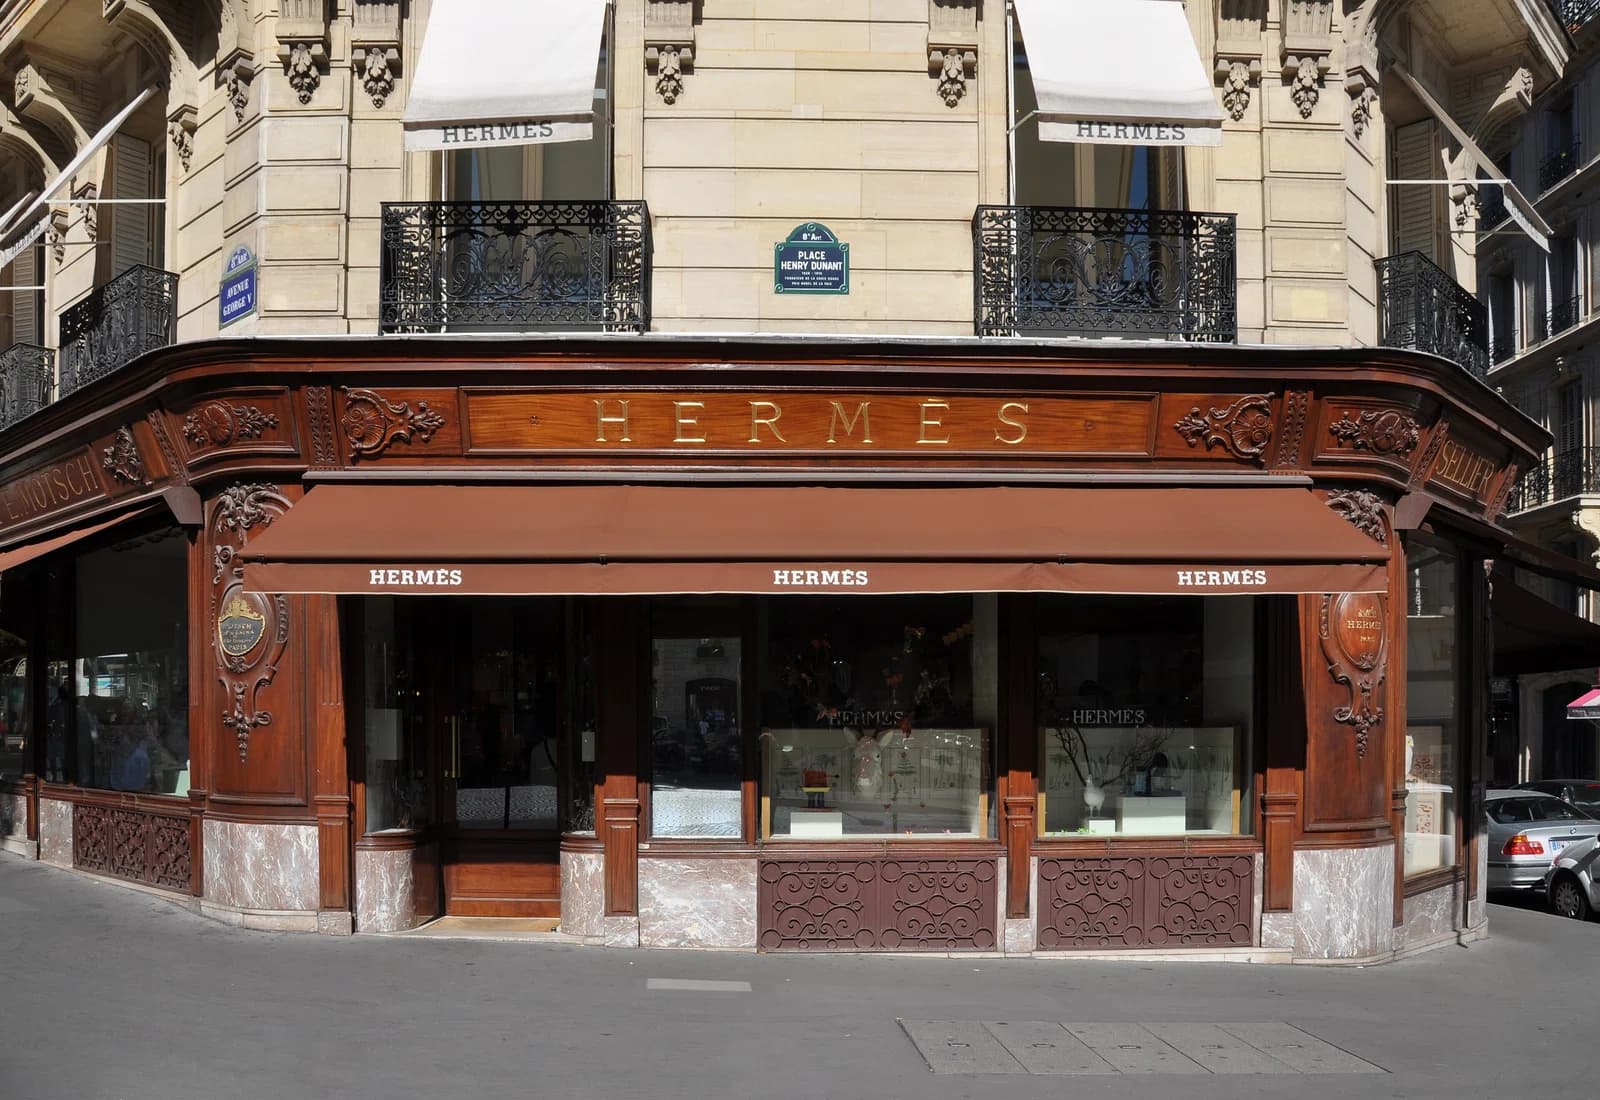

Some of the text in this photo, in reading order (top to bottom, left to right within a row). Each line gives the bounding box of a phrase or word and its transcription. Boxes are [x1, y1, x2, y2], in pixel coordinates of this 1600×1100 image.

[781, 260, 843, 271] HENRY DUNANT
[798, 250, 826, 260] PLACE
[227, 278, 249, 299] AVENUE
[223, 293, 252, 316] GEORGE V
[1435, 439, 1495, 497] SELLIER
